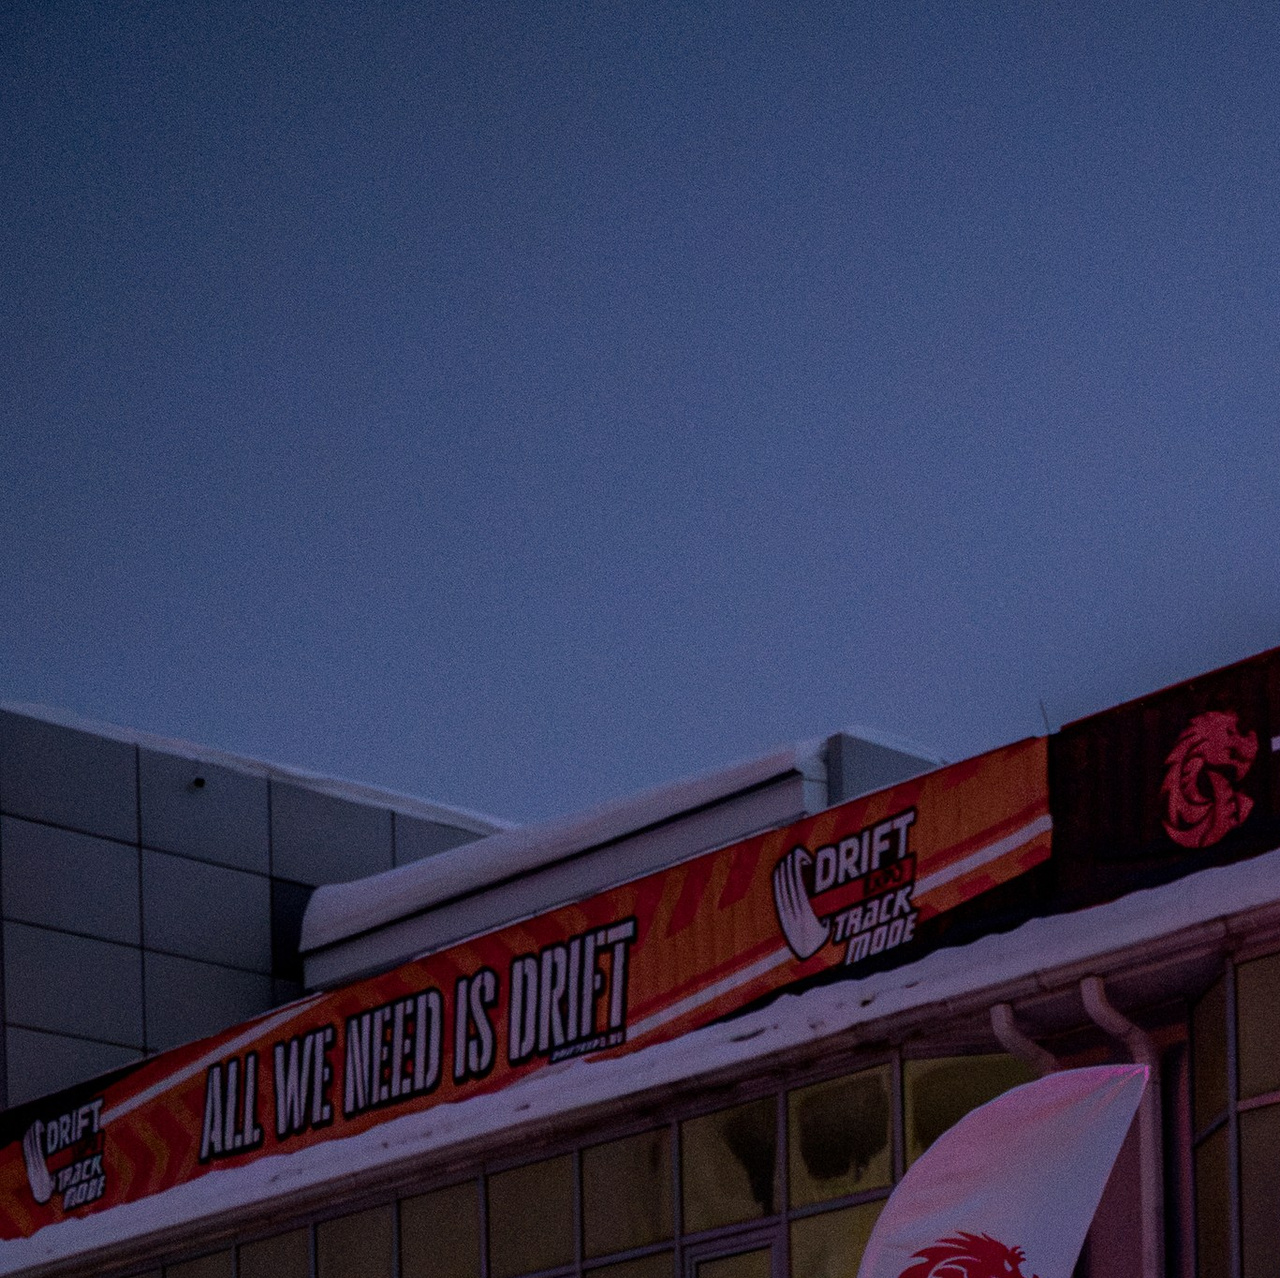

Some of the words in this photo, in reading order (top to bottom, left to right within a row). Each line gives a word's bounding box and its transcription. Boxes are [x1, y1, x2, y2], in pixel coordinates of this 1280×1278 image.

[813, 809, 917, 895] DRIFT
[833, 884, 913, 943] TRACK
[844, 910, 919, 967] MODE
[200, 1052, 262, 1161] ALL
[273, 1026, 334, 1137] WE
[344, 987, 442, 1116] NEED
[454, 967, 498, 1081] IS
[508, 918, 637, 1063] DRIFT
[46, 1097, 104, 1155] DRIFT
